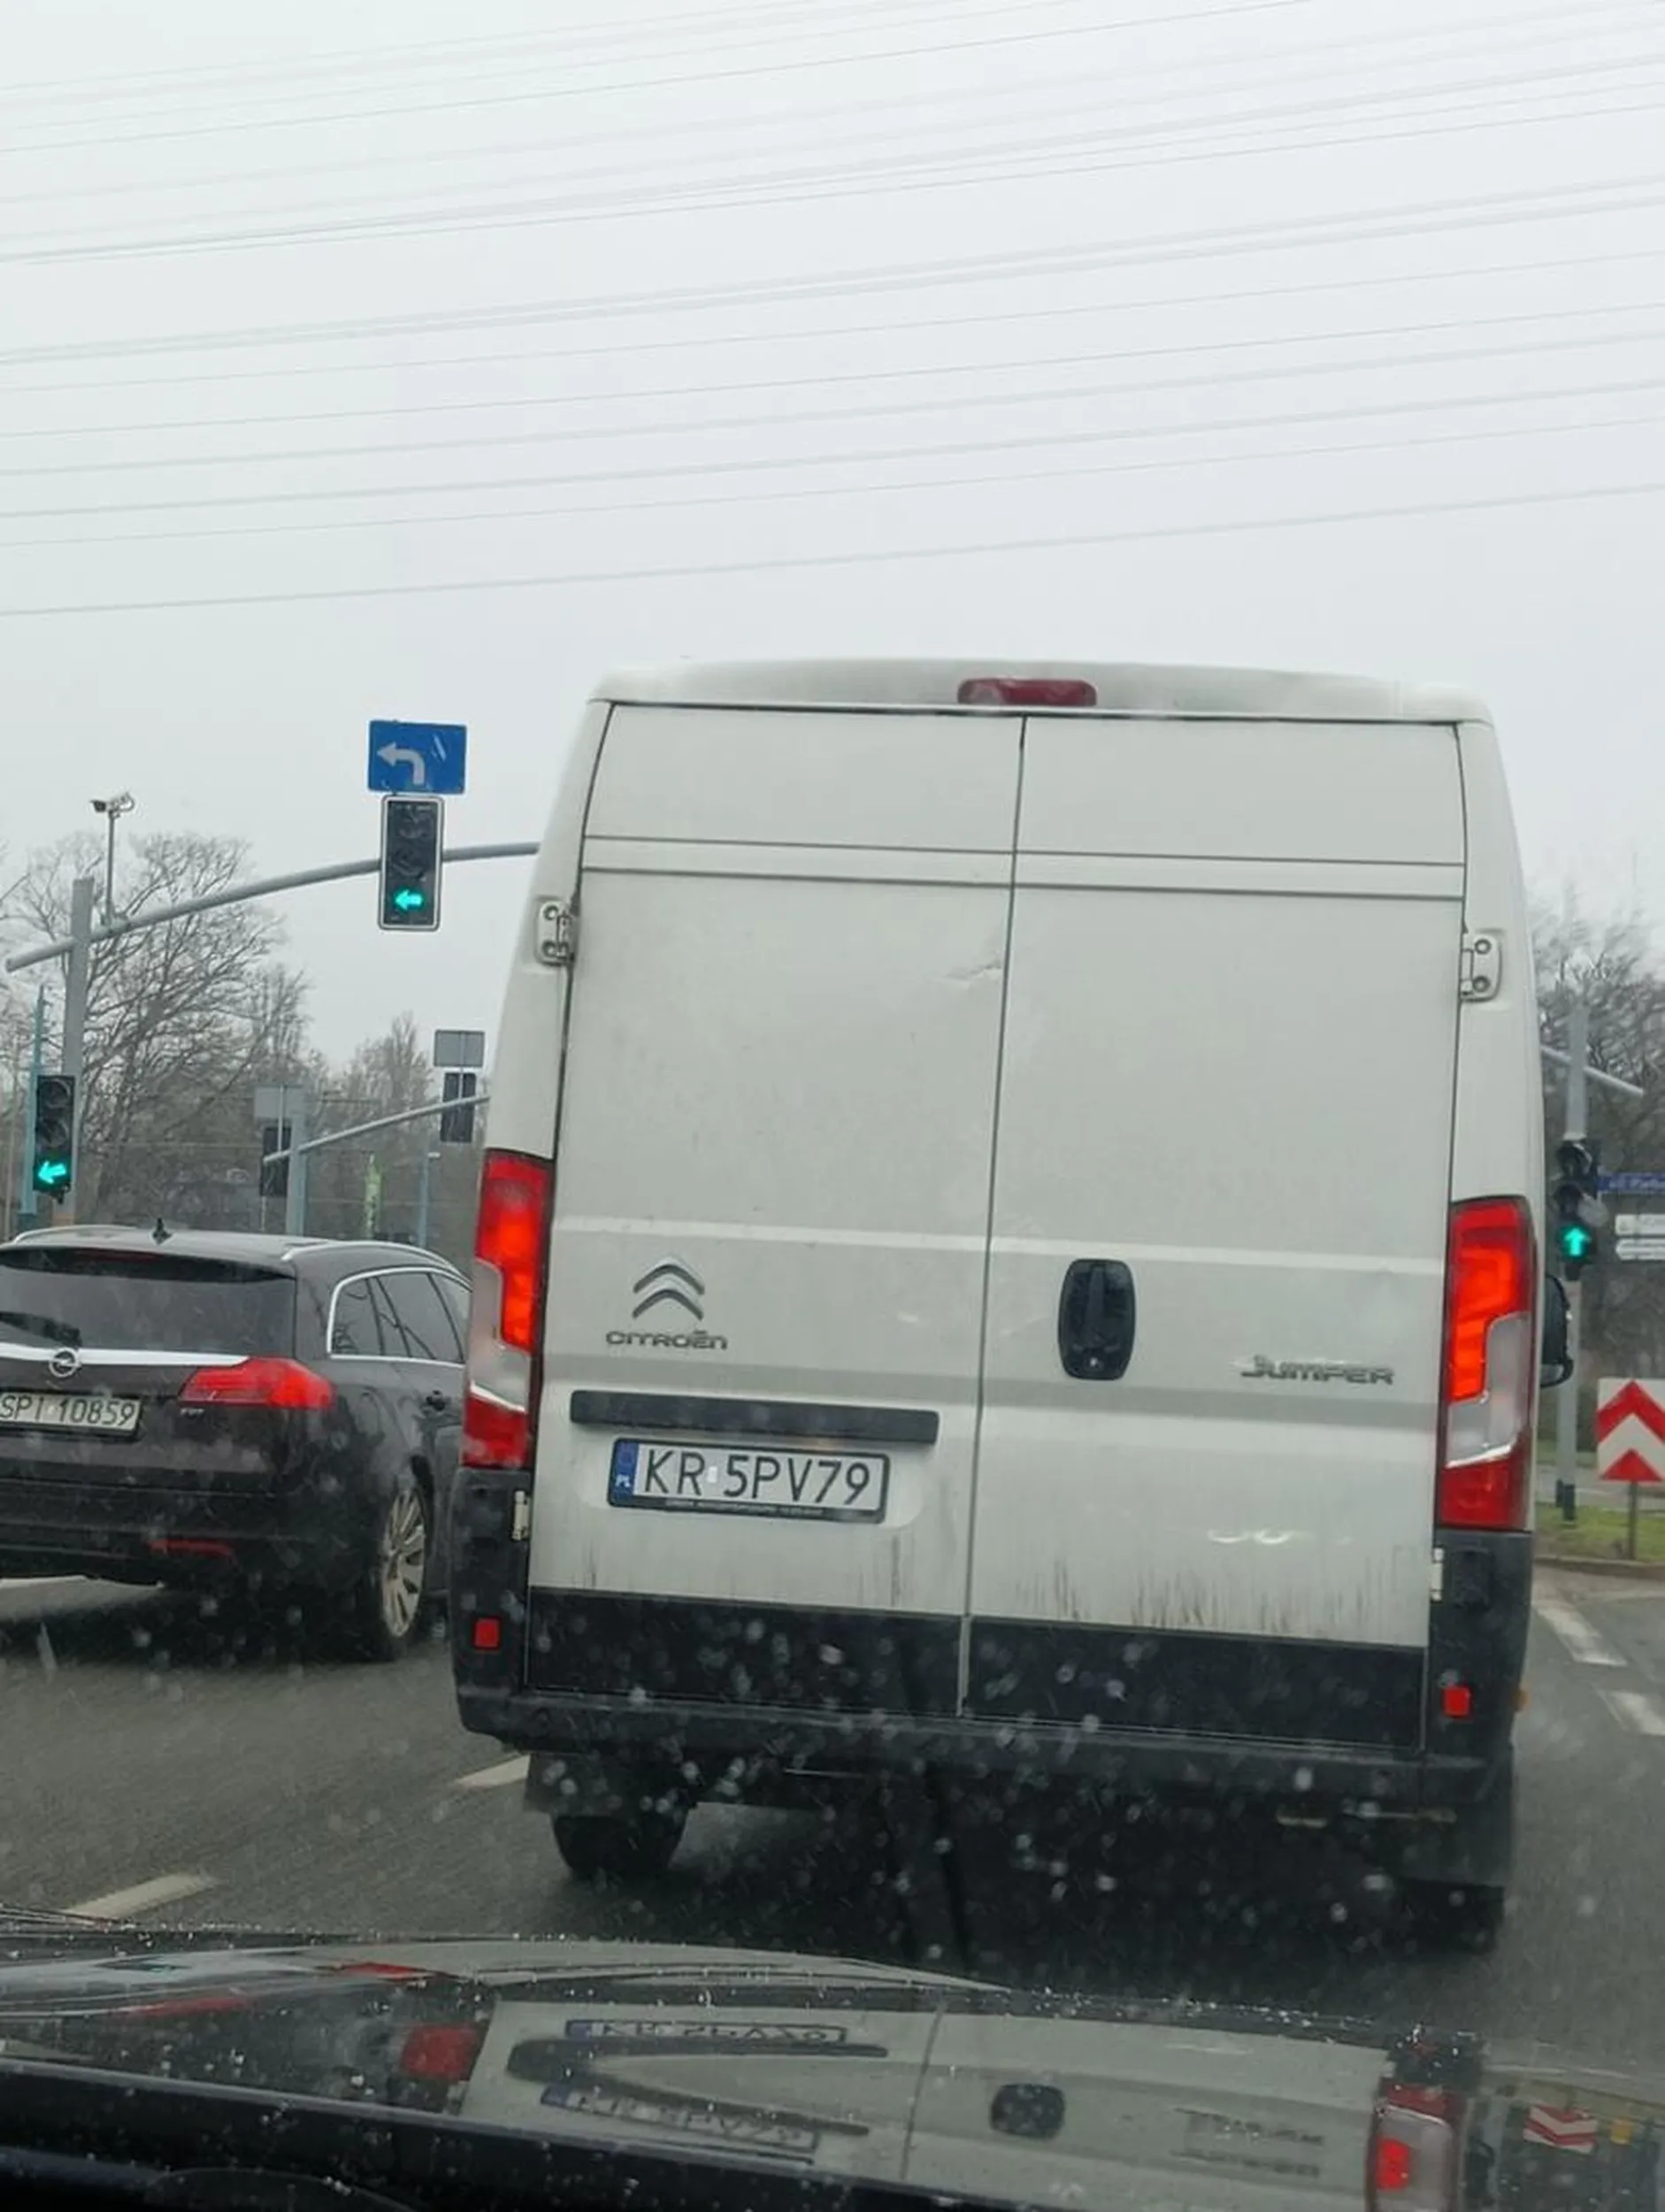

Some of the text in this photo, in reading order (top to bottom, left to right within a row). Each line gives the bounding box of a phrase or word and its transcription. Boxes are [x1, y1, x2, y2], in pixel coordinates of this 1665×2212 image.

[0, 1394, 135, 1426] SPI 10859
[644, 1448, 871, 1505] KR 5PV79
